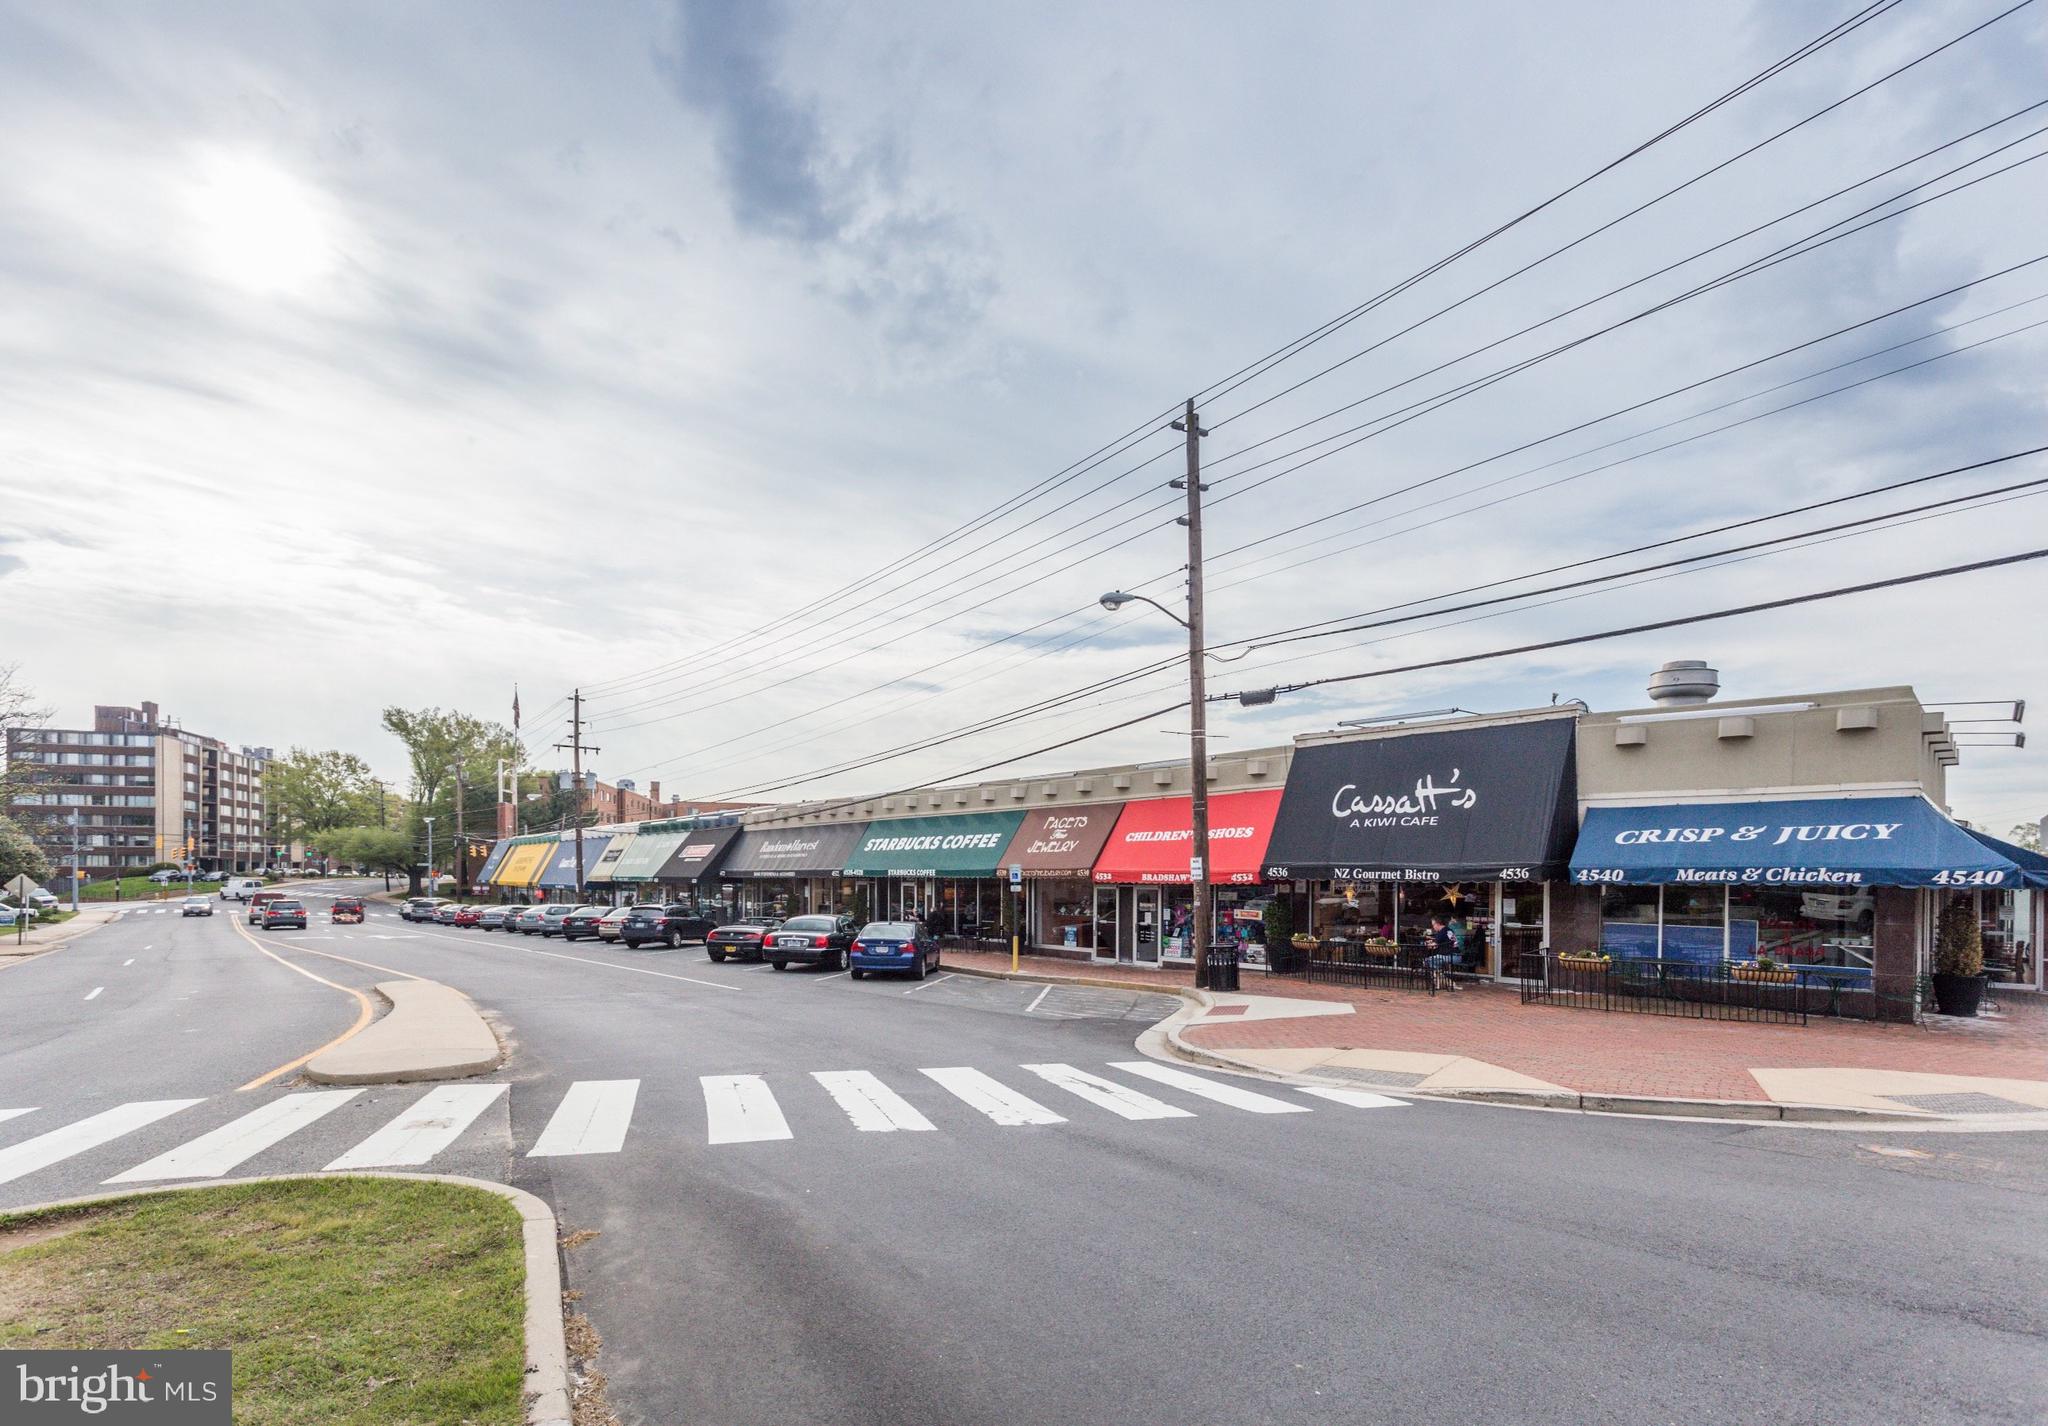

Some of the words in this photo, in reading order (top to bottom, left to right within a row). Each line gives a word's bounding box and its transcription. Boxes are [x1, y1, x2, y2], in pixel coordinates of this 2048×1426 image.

[1332, 768, 1477, 818] Cassatt's
[1350, 819, 1360, 828] A
[1364, 817, 1397, 828] KIWI
[1400, 816, 1439, 827] CAFE
[1125, 830, 1194, 843] CHILDREN'
[1207, 827, 1255, 840] SHOES
[1614, 827, 1725, 845] CRISP
[1731, 825, 1767, 841] &
[1773, 823, 1903, 846] JUICY
[864, 835, 943, 852] STARBUCKS
[941, 833, 1002, 850] COFFEE
[1027, 840, 1080, 854] JEWELRY
[1095, 872, 1112, 881] 4532
[1230, 872, 1254, 882] 4532
[1267, 867, 1289, 878] 4536
[1334, 868, 1350, 879] NZ
[1353, 868, 1401, 880] Gourmet
[1404, 869, 1440, 881] Bistro
[1499, 867, 1530, 880] 4536
[1576, 869, 1625, 882] 4540
[1675, 868, 1738, 883] Meats
[1742, 867, 1763, 881] &
[1765, 867, 1862, 884] Chicken
[1931, 870, 2005, 885] 4540
